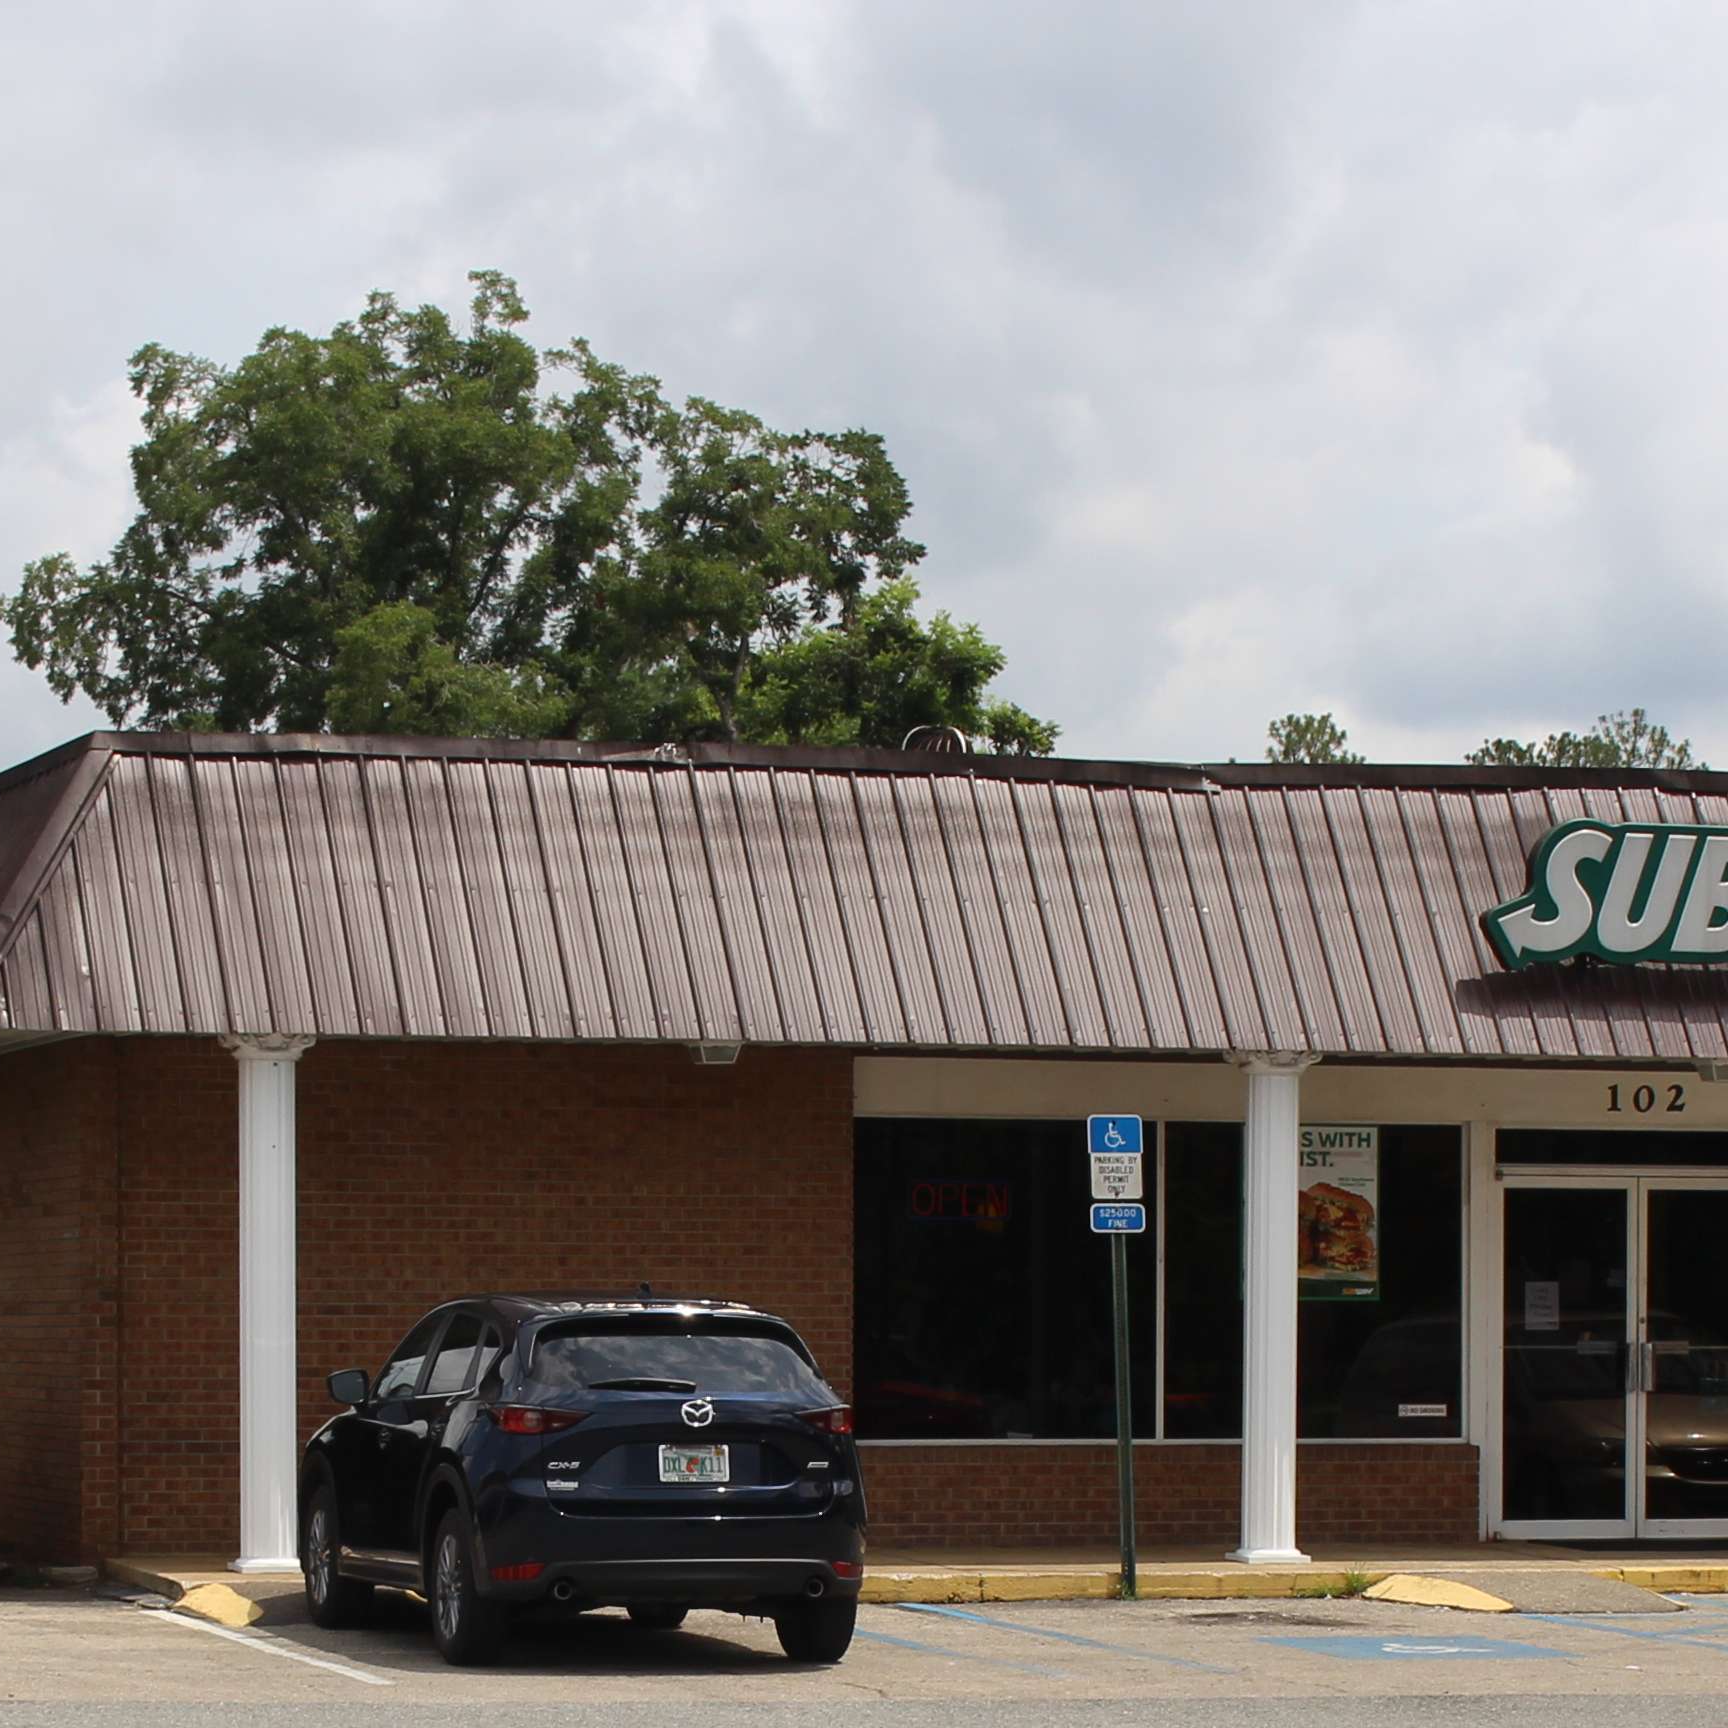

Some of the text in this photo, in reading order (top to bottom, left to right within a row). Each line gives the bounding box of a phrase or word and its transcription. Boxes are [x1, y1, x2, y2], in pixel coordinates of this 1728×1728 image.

[1607, 1083, 1686, 1113] 102
[1318, 1131, 1371, 1149] WITH
[1094, 1155, 1138, 1165] PARKING BY
[1098, 1165, 1134, 1174] DISABLED
[1102, 1175, 1130, 1184] PERMIT
[1107, 1184, 1126, 1194] ONLY
[912, 1183, 1009, 1217] OPEN
[1107, 1219, 1129, 1228] FINE
